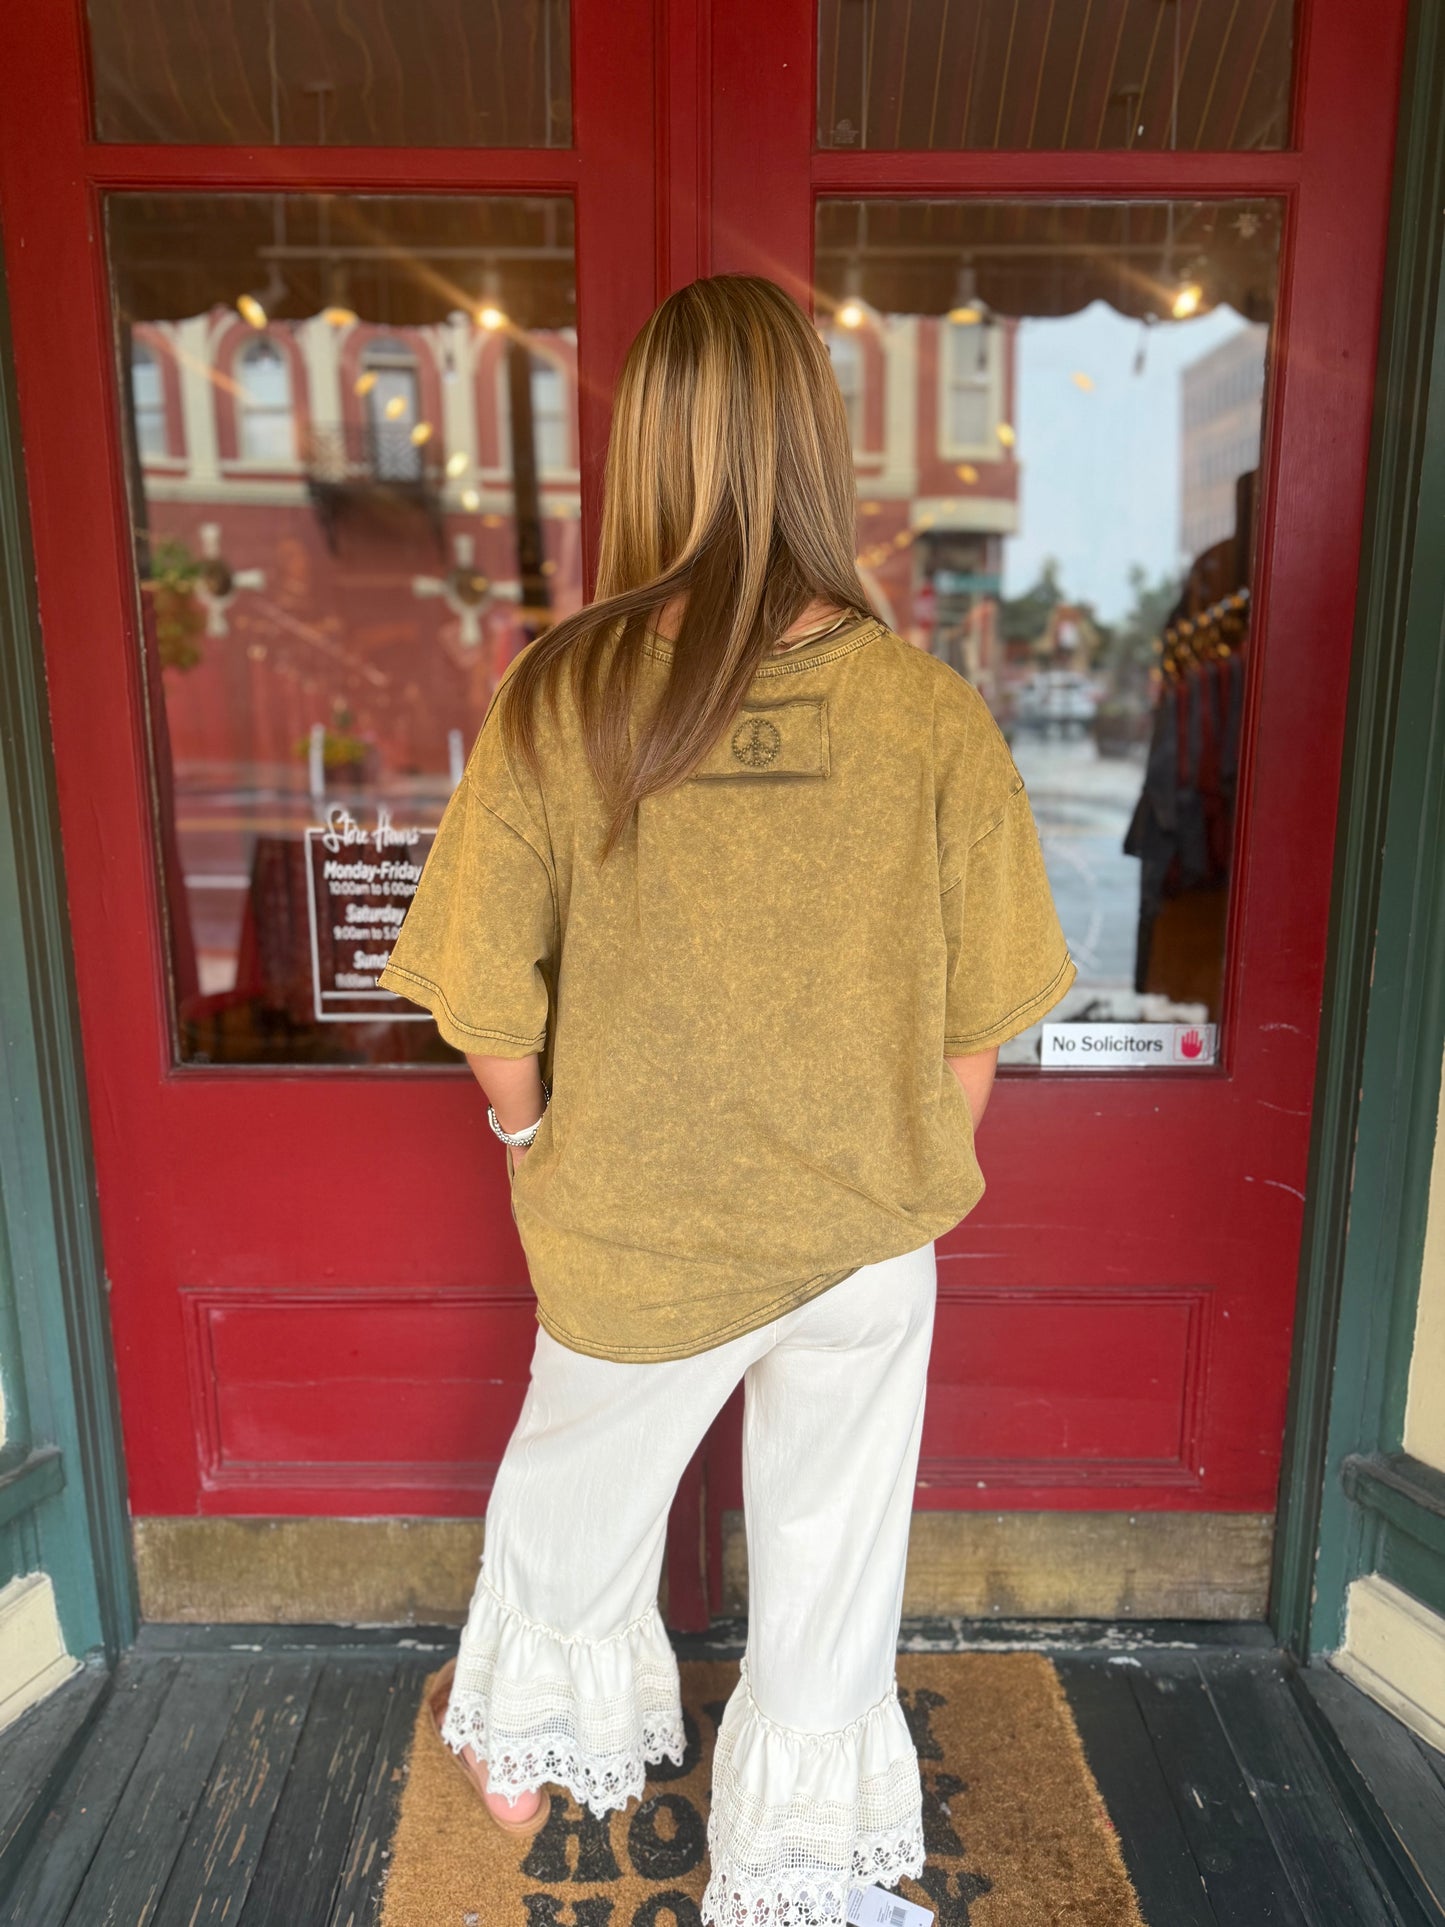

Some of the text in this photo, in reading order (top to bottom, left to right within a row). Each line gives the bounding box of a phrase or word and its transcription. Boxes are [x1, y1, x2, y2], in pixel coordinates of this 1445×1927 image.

[323, 860, 422, 883] Monday-Friday
[371, 882, 382, 895] to
[345, 903, 406, 926] Saturday
[371, 927, 383, 940] to
[353, 950, 390, 970] Sund
[1053, 1036, 1163, 1052] No Solicitors
